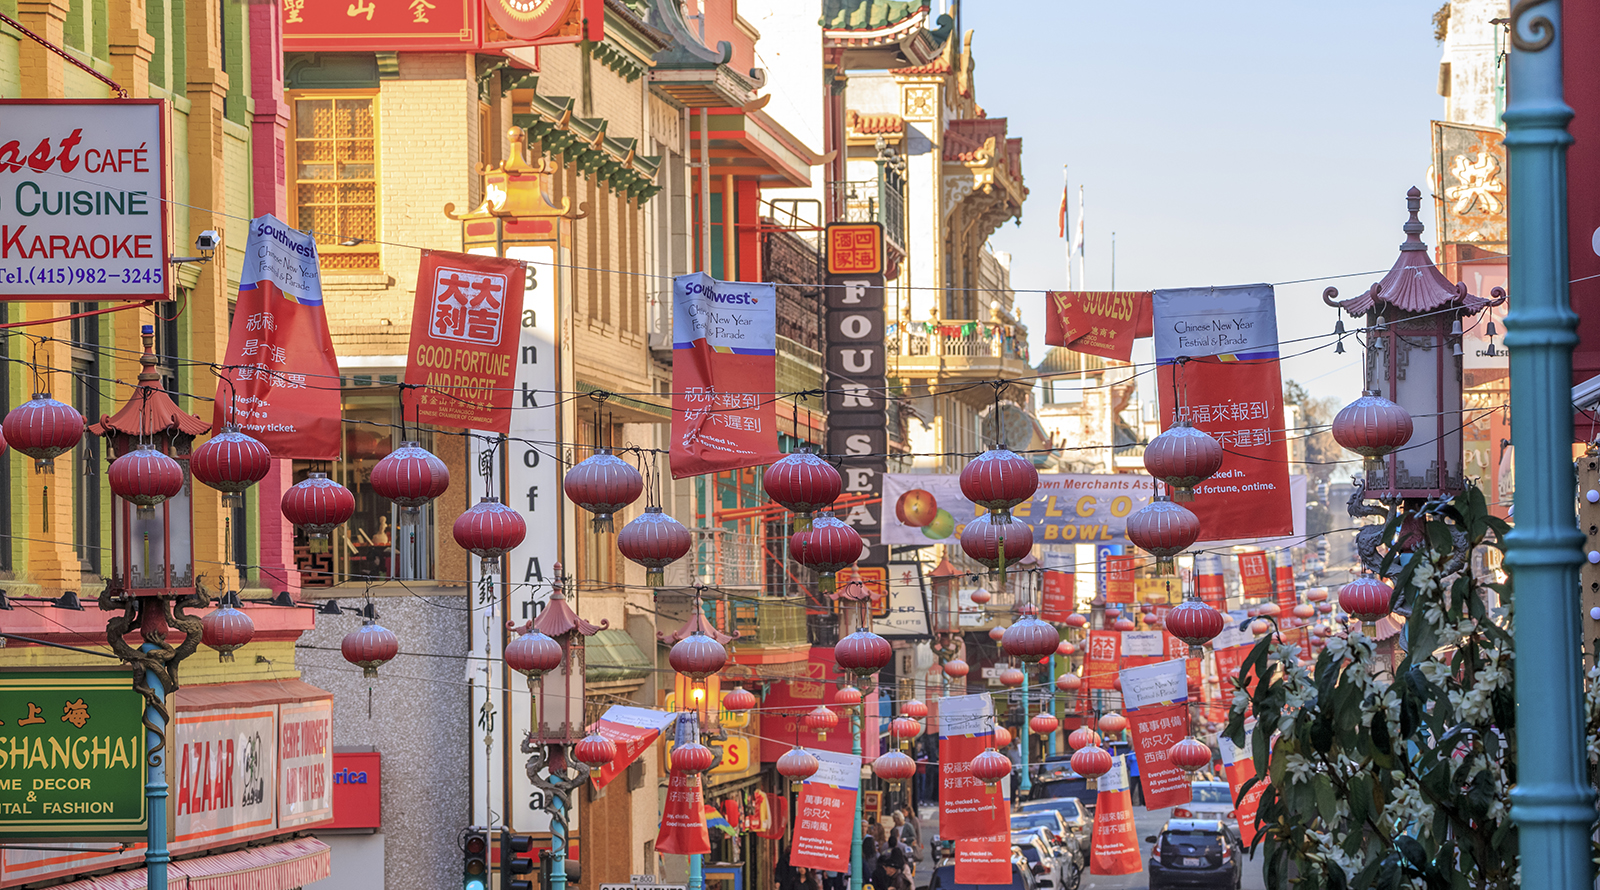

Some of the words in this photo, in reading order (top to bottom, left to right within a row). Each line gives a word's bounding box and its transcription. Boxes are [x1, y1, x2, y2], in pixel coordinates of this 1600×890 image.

[85, 142, 149, 173] CAFÉ
[257, 223, 315, 259] Southwest
[257, 245, 282, 265] Chinese
[283, 257, 298, 274] New
[298, 264, 318, 279] Year
[279, 272, 285, 281] &
[285, 273, 311, 292] Parade
[685, 282, 751, 305] Southwest
[1082, 292, 1136, 322] SUCCESS
[709, 312, 731, 325] New
[731, 314, 754, 326] Year
[1174, 319, 1212, 335] Chinese
[1212, 319, 1233, 332] New
[1232, 318, 1255, 331] Year
[708, 328, 715, 337] &
[715, 326, 746, 340] Parade
[839, 279, 875, 408] FOUR
[1178, 335, 1210, 349] Festival
[1210, 337, 1218, 346] &
[1218, 334, 1249, 348] Parade
[241, 338, 286, 366] 是一張
[416, 344, 453, 369] GOOD
[454, 347, 511, 377] FORTUNE
[424, 372, 451, 396] AND
[451, 375, 497, 401] PROFIT
[228, 405, 260, 419] They're
[418, 409, 438, 417] CHINESE
[438, 411, 460, 420] CHAMBER
[467, 416, 493, 424] COMMERCE
[267, 423, 297, 433] ticket.
[1234, 469, 1246, 478] in.
[1063, 478, 1129, 491] Merchants
[1203, 484, 1240, 494] fortune,
[1241, 481, 1277, 492] ontime.
[1044, 524, 1114, 541] BOWL
[1132, 684, 1155, 694] Chinese
[1154, 681, 1168, 691] New
[1167, 679, 1180, 688] Year
[1159, 687, 1178, 697] Parade
[282, 720, 300, 760] SERVE
[1144, 749, 1170, 764] 西南
[177, 738, 235, 817] AZAAR
[1147, 766, 1179, 779] Everything's
[33, 778, 91, 790] DECOR
[310, 762, 326, 801] LESS
[1150, 781, 1187, 795] Southwesterly
[1157, 778, 1167, 787] you
[1167, 774, 1180, 784] need
[26, 790, 38, 802] &
[954, 798, 973, 806] checked
[43, 802, 114, 814] FASHION
[803, 807, 831, 820] 你只欠
[799, 836, 825, 845] Everything's
[797, 849, 828, 859] Southwesterly
